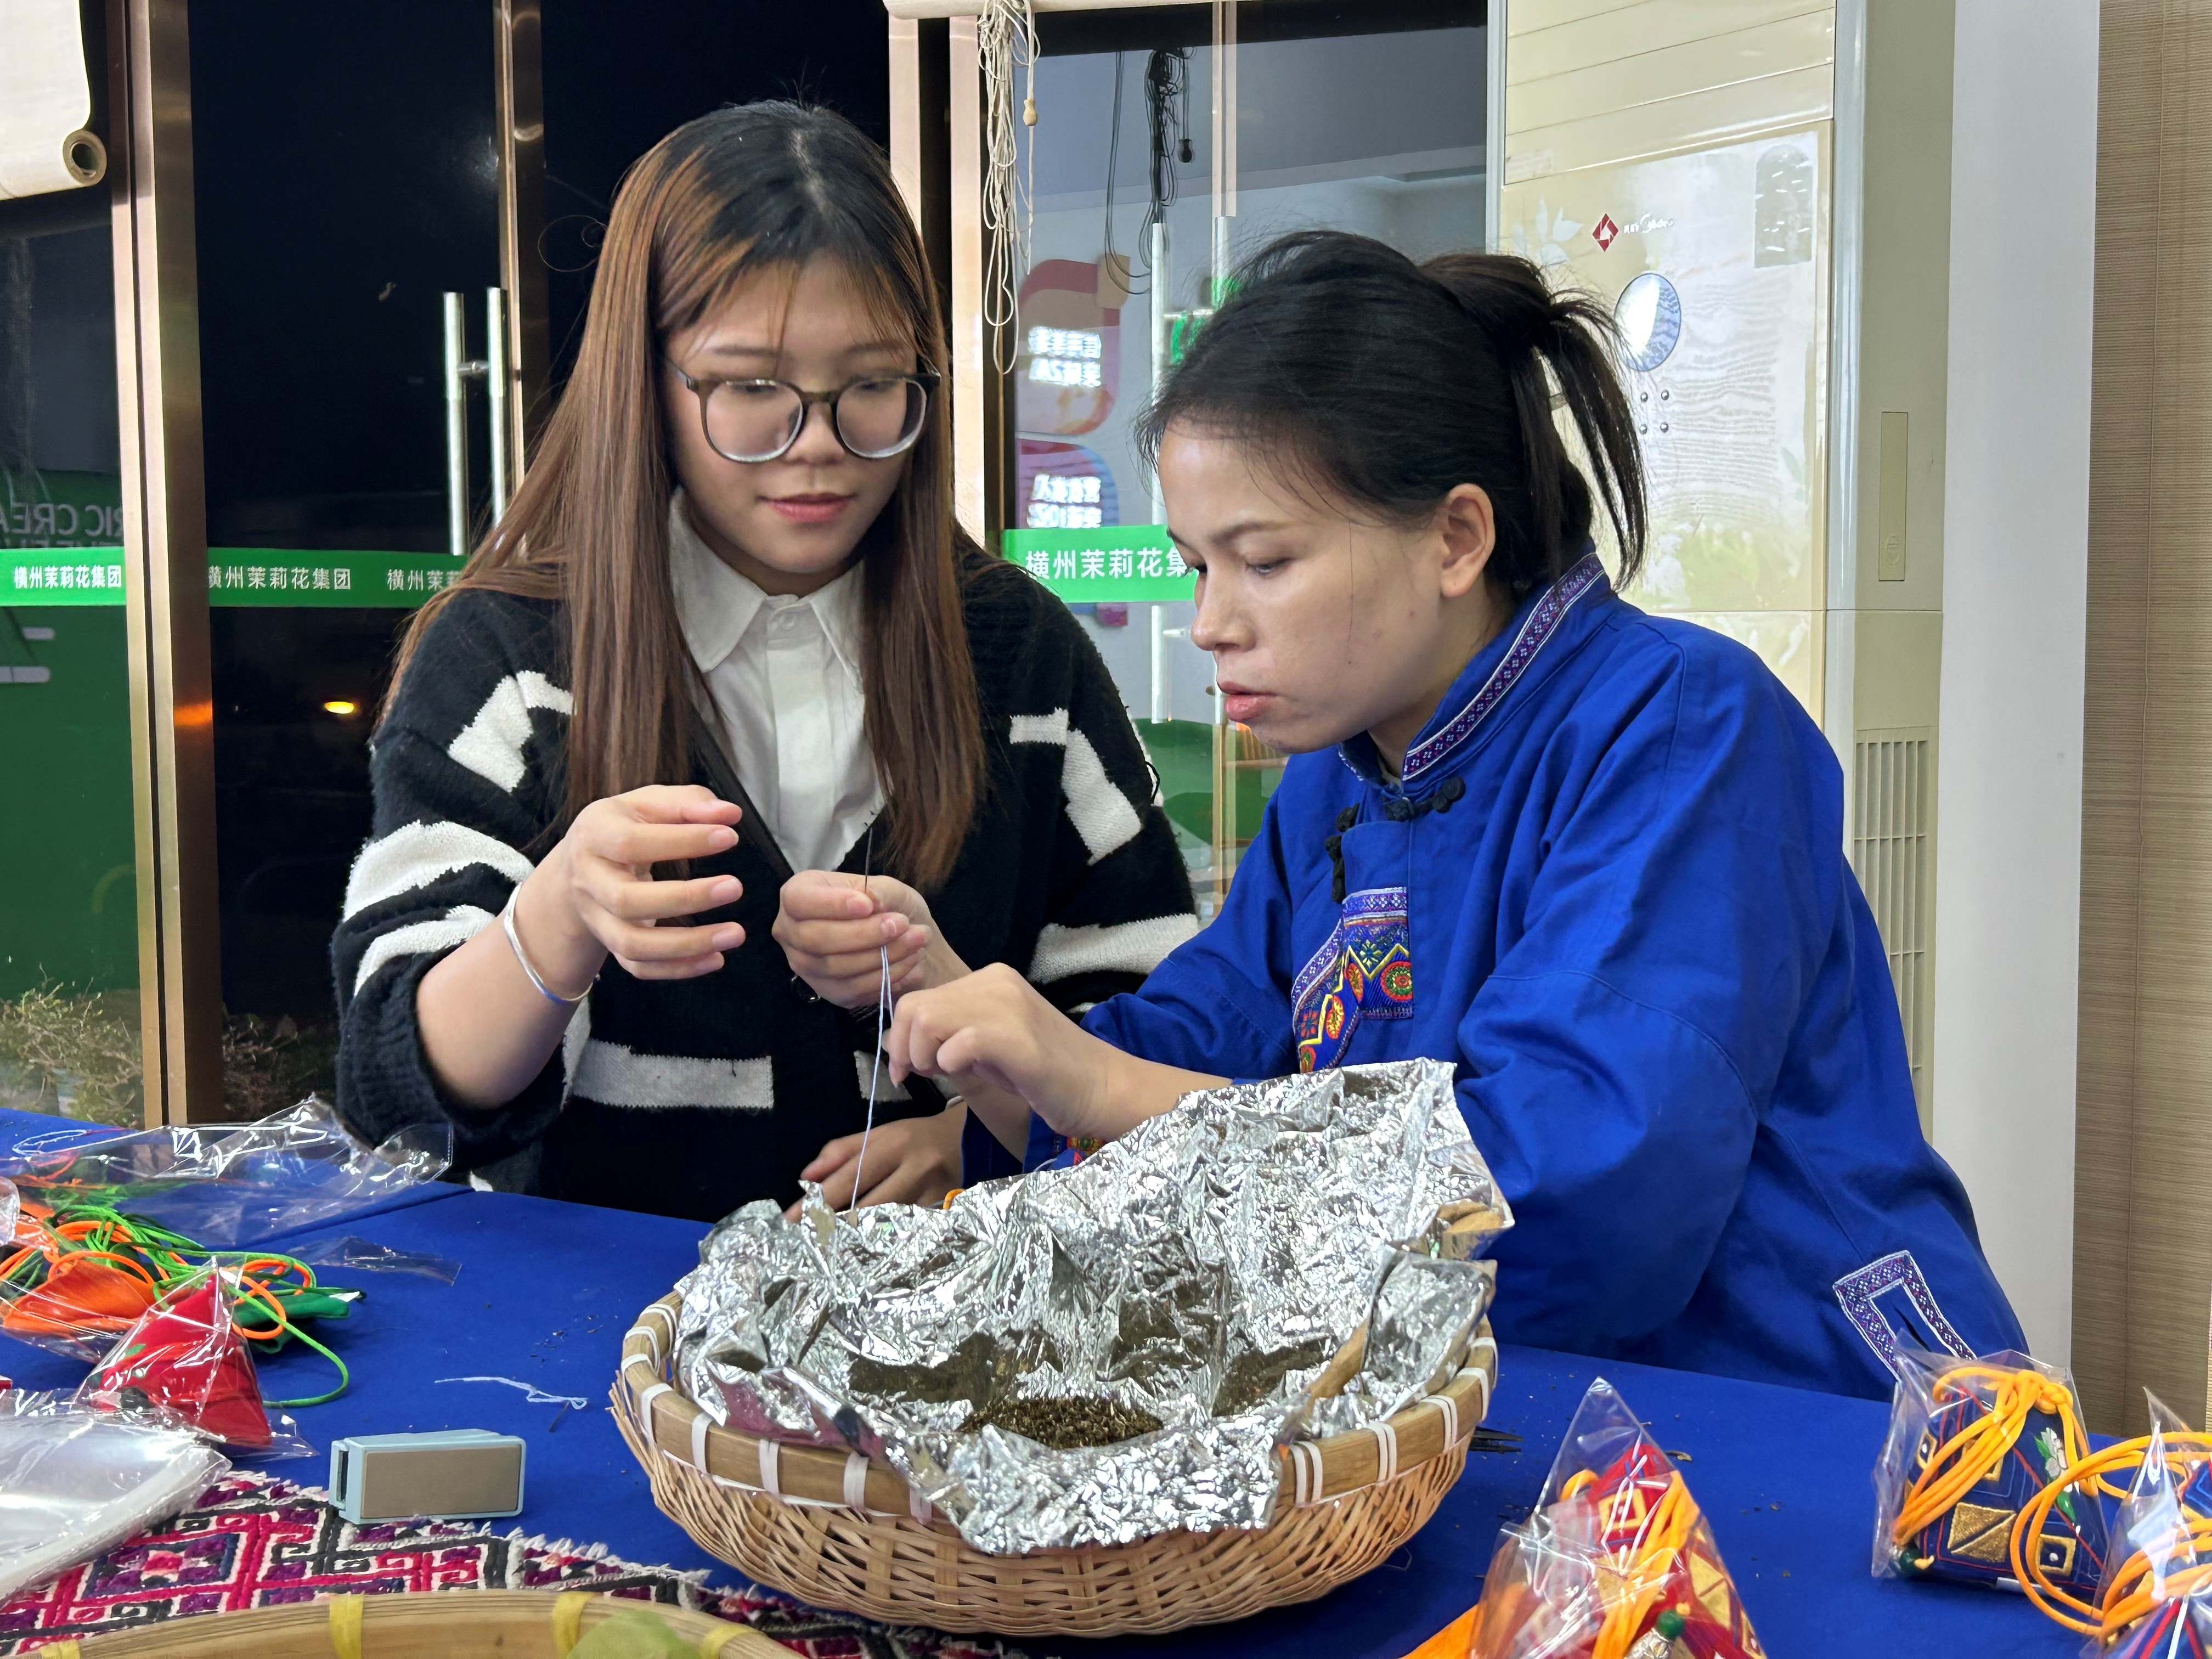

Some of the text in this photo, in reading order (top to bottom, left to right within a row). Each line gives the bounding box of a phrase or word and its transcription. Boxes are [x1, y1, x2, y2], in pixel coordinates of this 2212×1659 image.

[14, 565, 122, 589] 横州茉莉花集团
